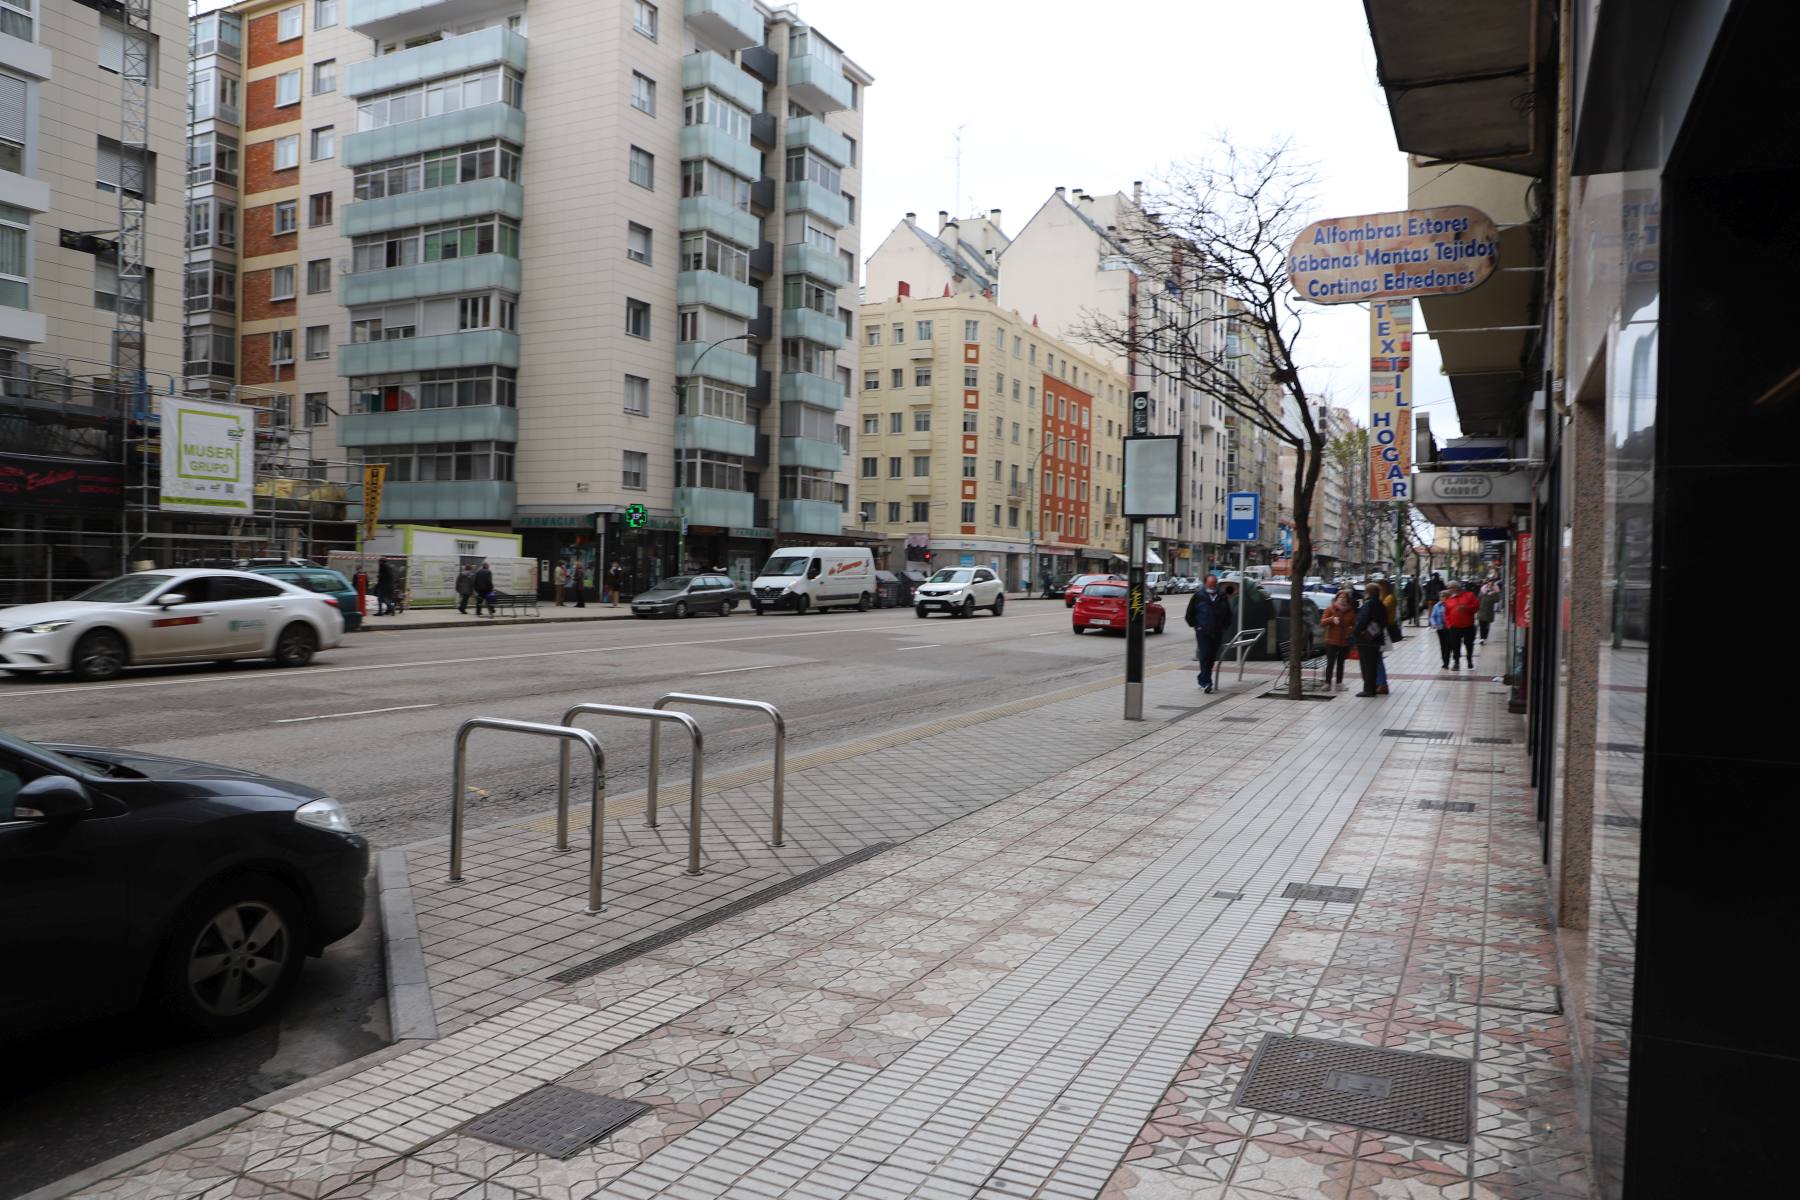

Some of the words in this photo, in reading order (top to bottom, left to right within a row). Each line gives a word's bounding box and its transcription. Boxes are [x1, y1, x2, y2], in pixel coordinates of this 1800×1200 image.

[1313, 221, 1402, 245] Alfombras
[1407, 216, 1469, 237] Estores
[1291, 251, 1360, 273] Sábanas
[1364, 247, 1430, 266] Mantas
[1435, 238, 1496, 262] Tejidos
[1308, 278, 1379, 297] Cortinas
[1383, 269, 1476, 291] Edredones
[1374, 304, 1408, 407] TEXTIL
[184, 443, 235, 460] MUSER
[1373, 412, 1408, 497] HOGAR
[191, 460, 230, 474] GRUPO
[520, 516, 577, 527] FARMACIA
